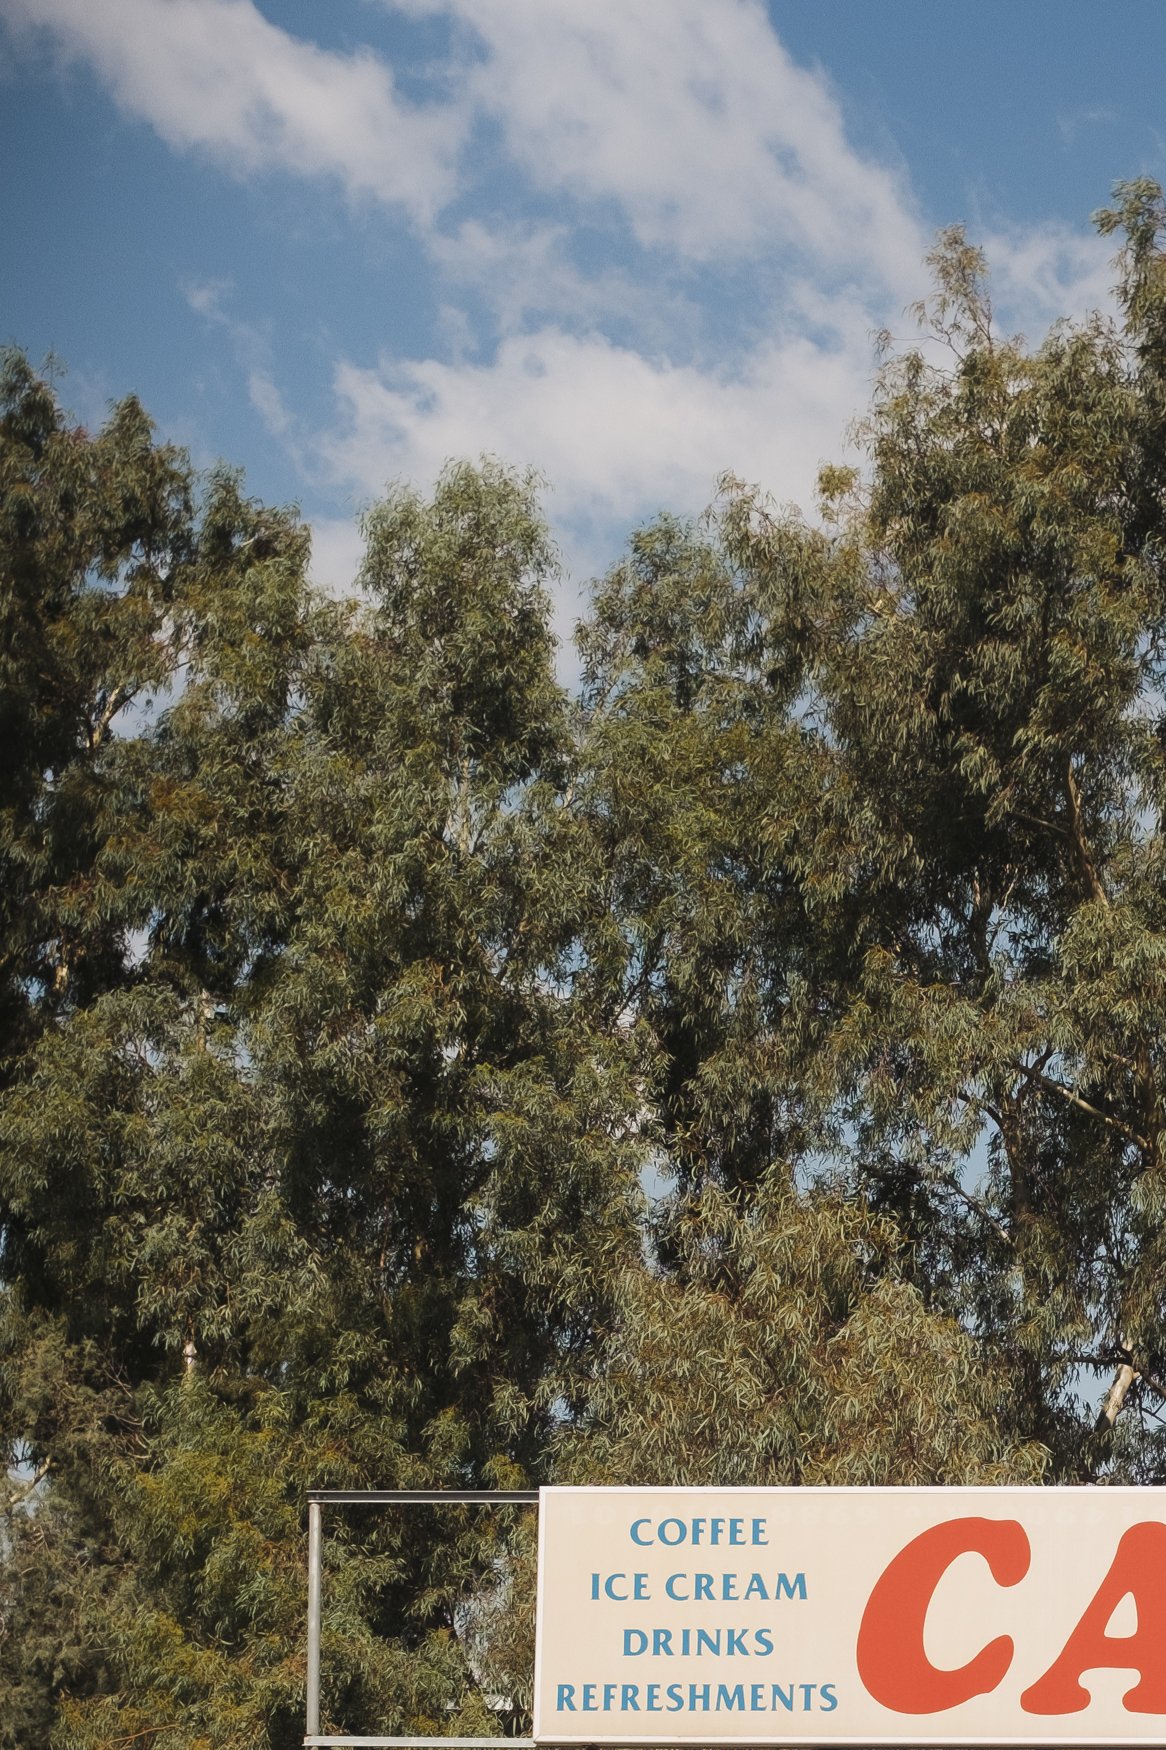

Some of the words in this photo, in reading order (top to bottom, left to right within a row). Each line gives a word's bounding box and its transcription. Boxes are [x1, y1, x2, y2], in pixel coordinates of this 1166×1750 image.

[630, 1518, 768, 1547] COFFEE
[591, 1572, 650, 1601] ICE
[665, 1572, 808, 1601] CREAM
[623, 1628, 774, 1657] DRINKS
[556, 1683, 838, 1713] REFRESHMENTS
